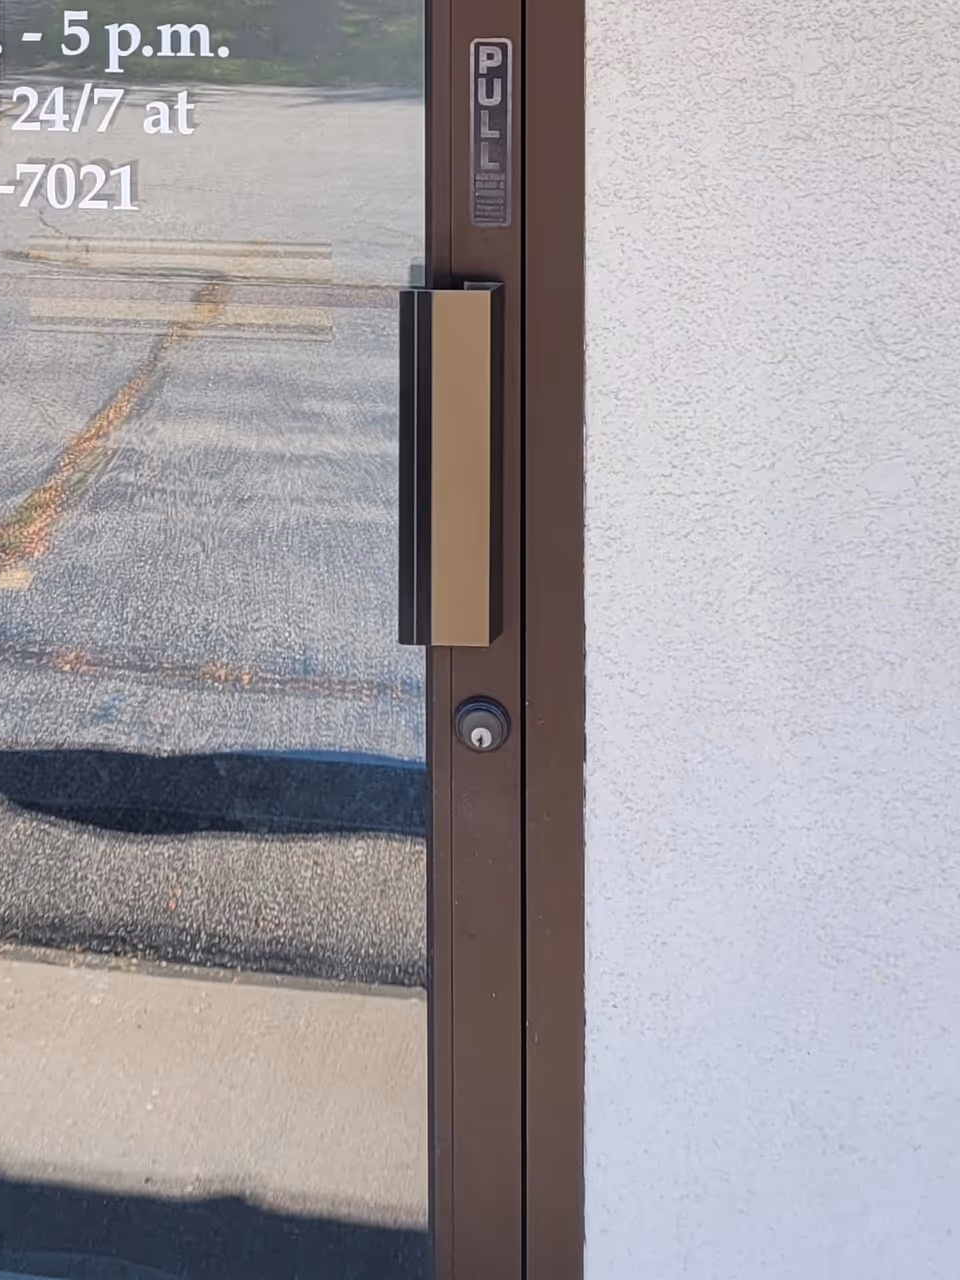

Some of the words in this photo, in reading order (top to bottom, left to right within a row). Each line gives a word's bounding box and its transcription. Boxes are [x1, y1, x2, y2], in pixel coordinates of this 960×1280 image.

[60, 10, 91, 56] 5
[104, 22, 230, 73] p.m.
[10, 82, 125, 133] 24/7
[142, 88, 196, 135] at
[477, 45, 503, 170] PULL
